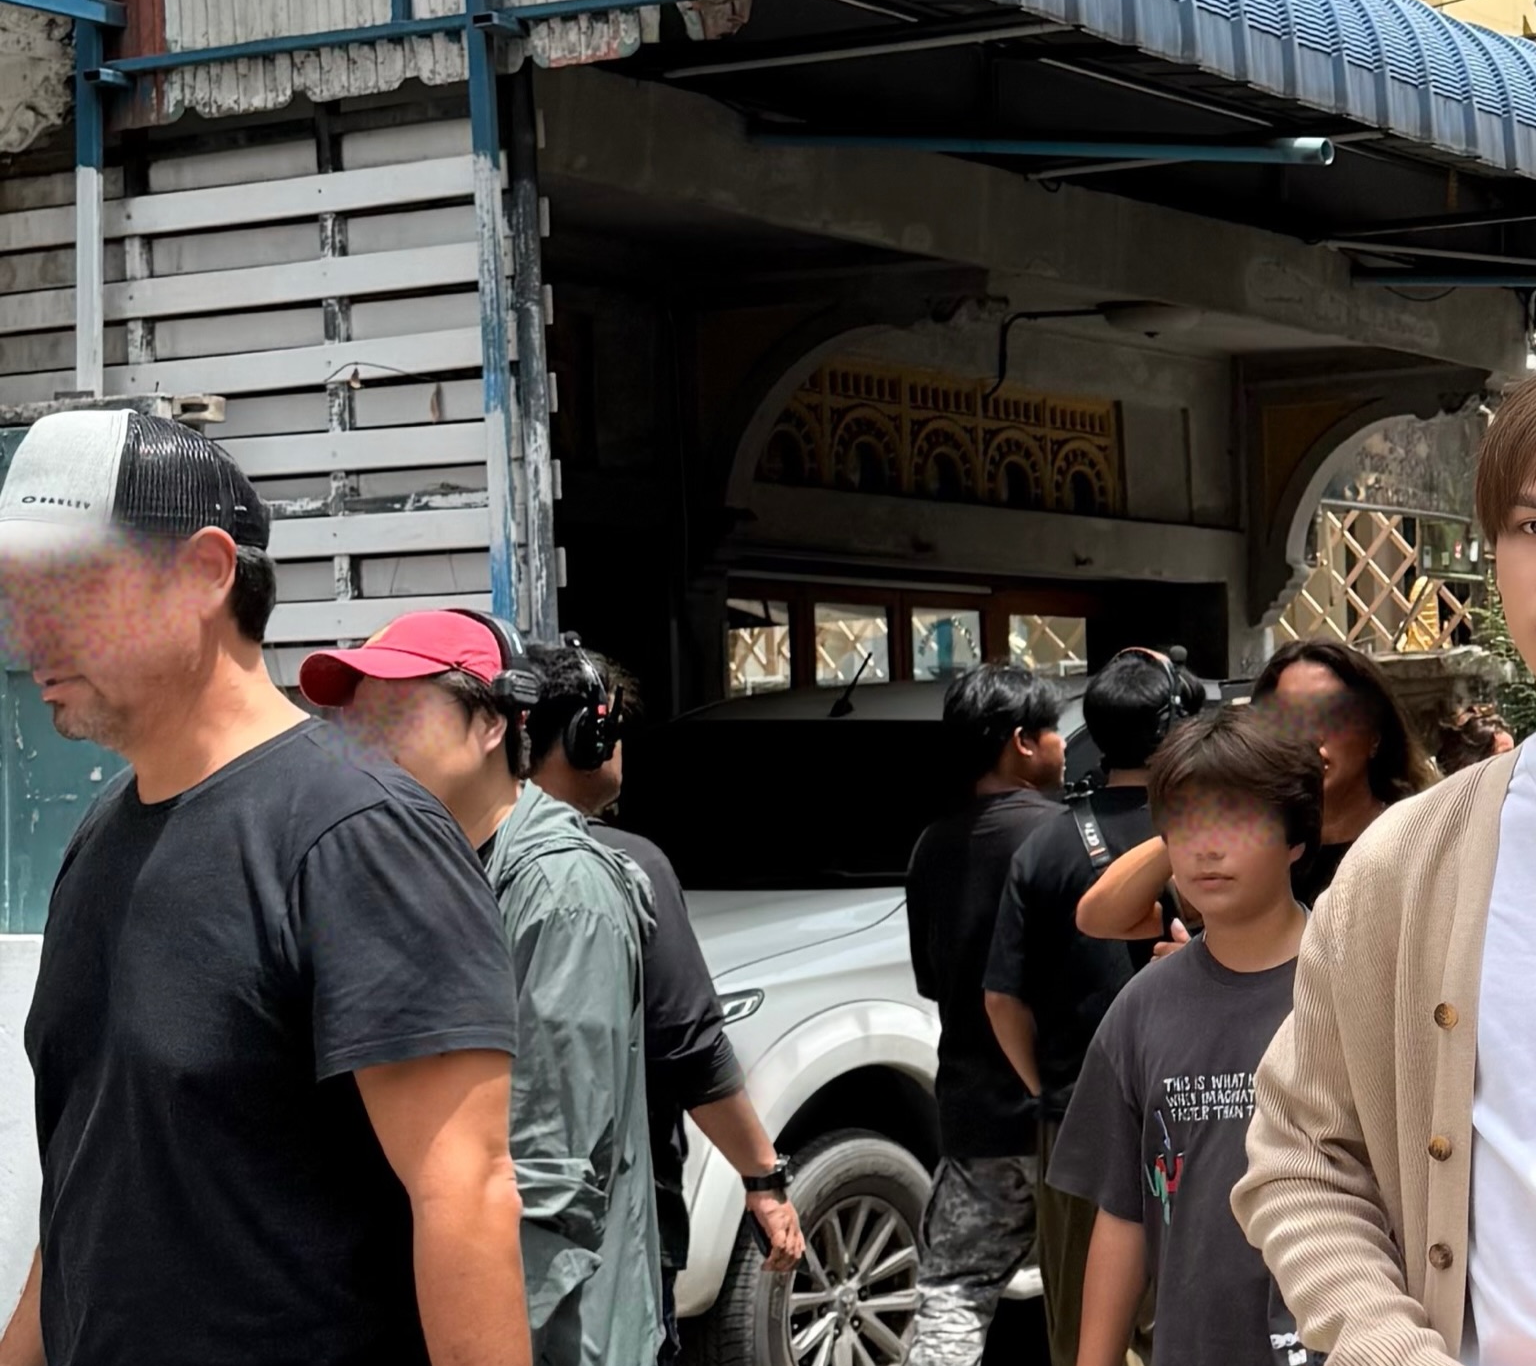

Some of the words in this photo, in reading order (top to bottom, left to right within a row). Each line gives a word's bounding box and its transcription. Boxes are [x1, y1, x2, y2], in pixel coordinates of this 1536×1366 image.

[1163, 1075, 1191, 1093] THIS
[1194, 1075, 1206, 1090] IS
[1211, 1072, 1245, 1089] WHAT
[1201, 1088, 1256, 1105] IMAGINAT
[1170, 1105, 1210, 1123] FASTER
[1213, 1104, 1244, 1120] THAN
